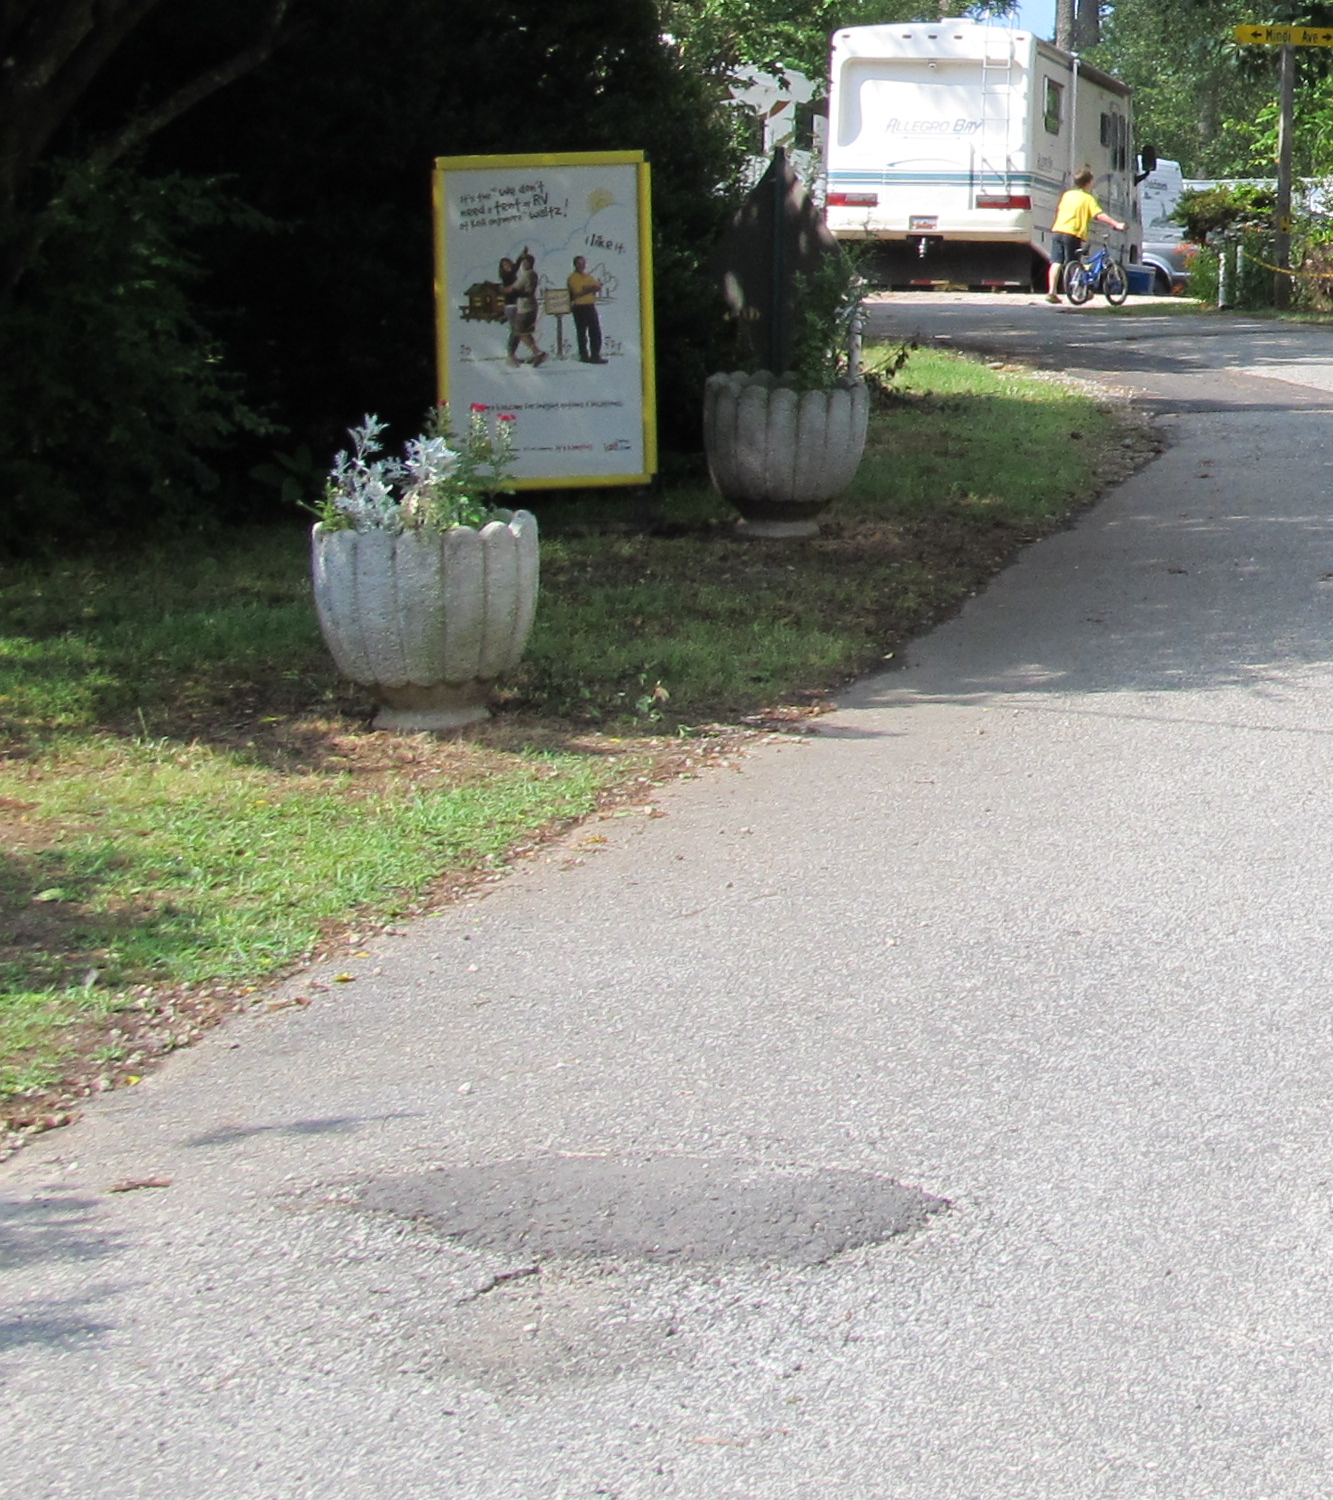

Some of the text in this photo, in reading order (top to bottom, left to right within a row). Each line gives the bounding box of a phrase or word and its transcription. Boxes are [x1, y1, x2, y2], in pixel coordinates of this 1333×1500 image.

[1302, 30, 1318, 43] Ave
[461, 205, 486, 216] need
[494, 198, 521, 215] tent
[532, 192, 549, 206] RV
[590, 233, 614, 250] like
